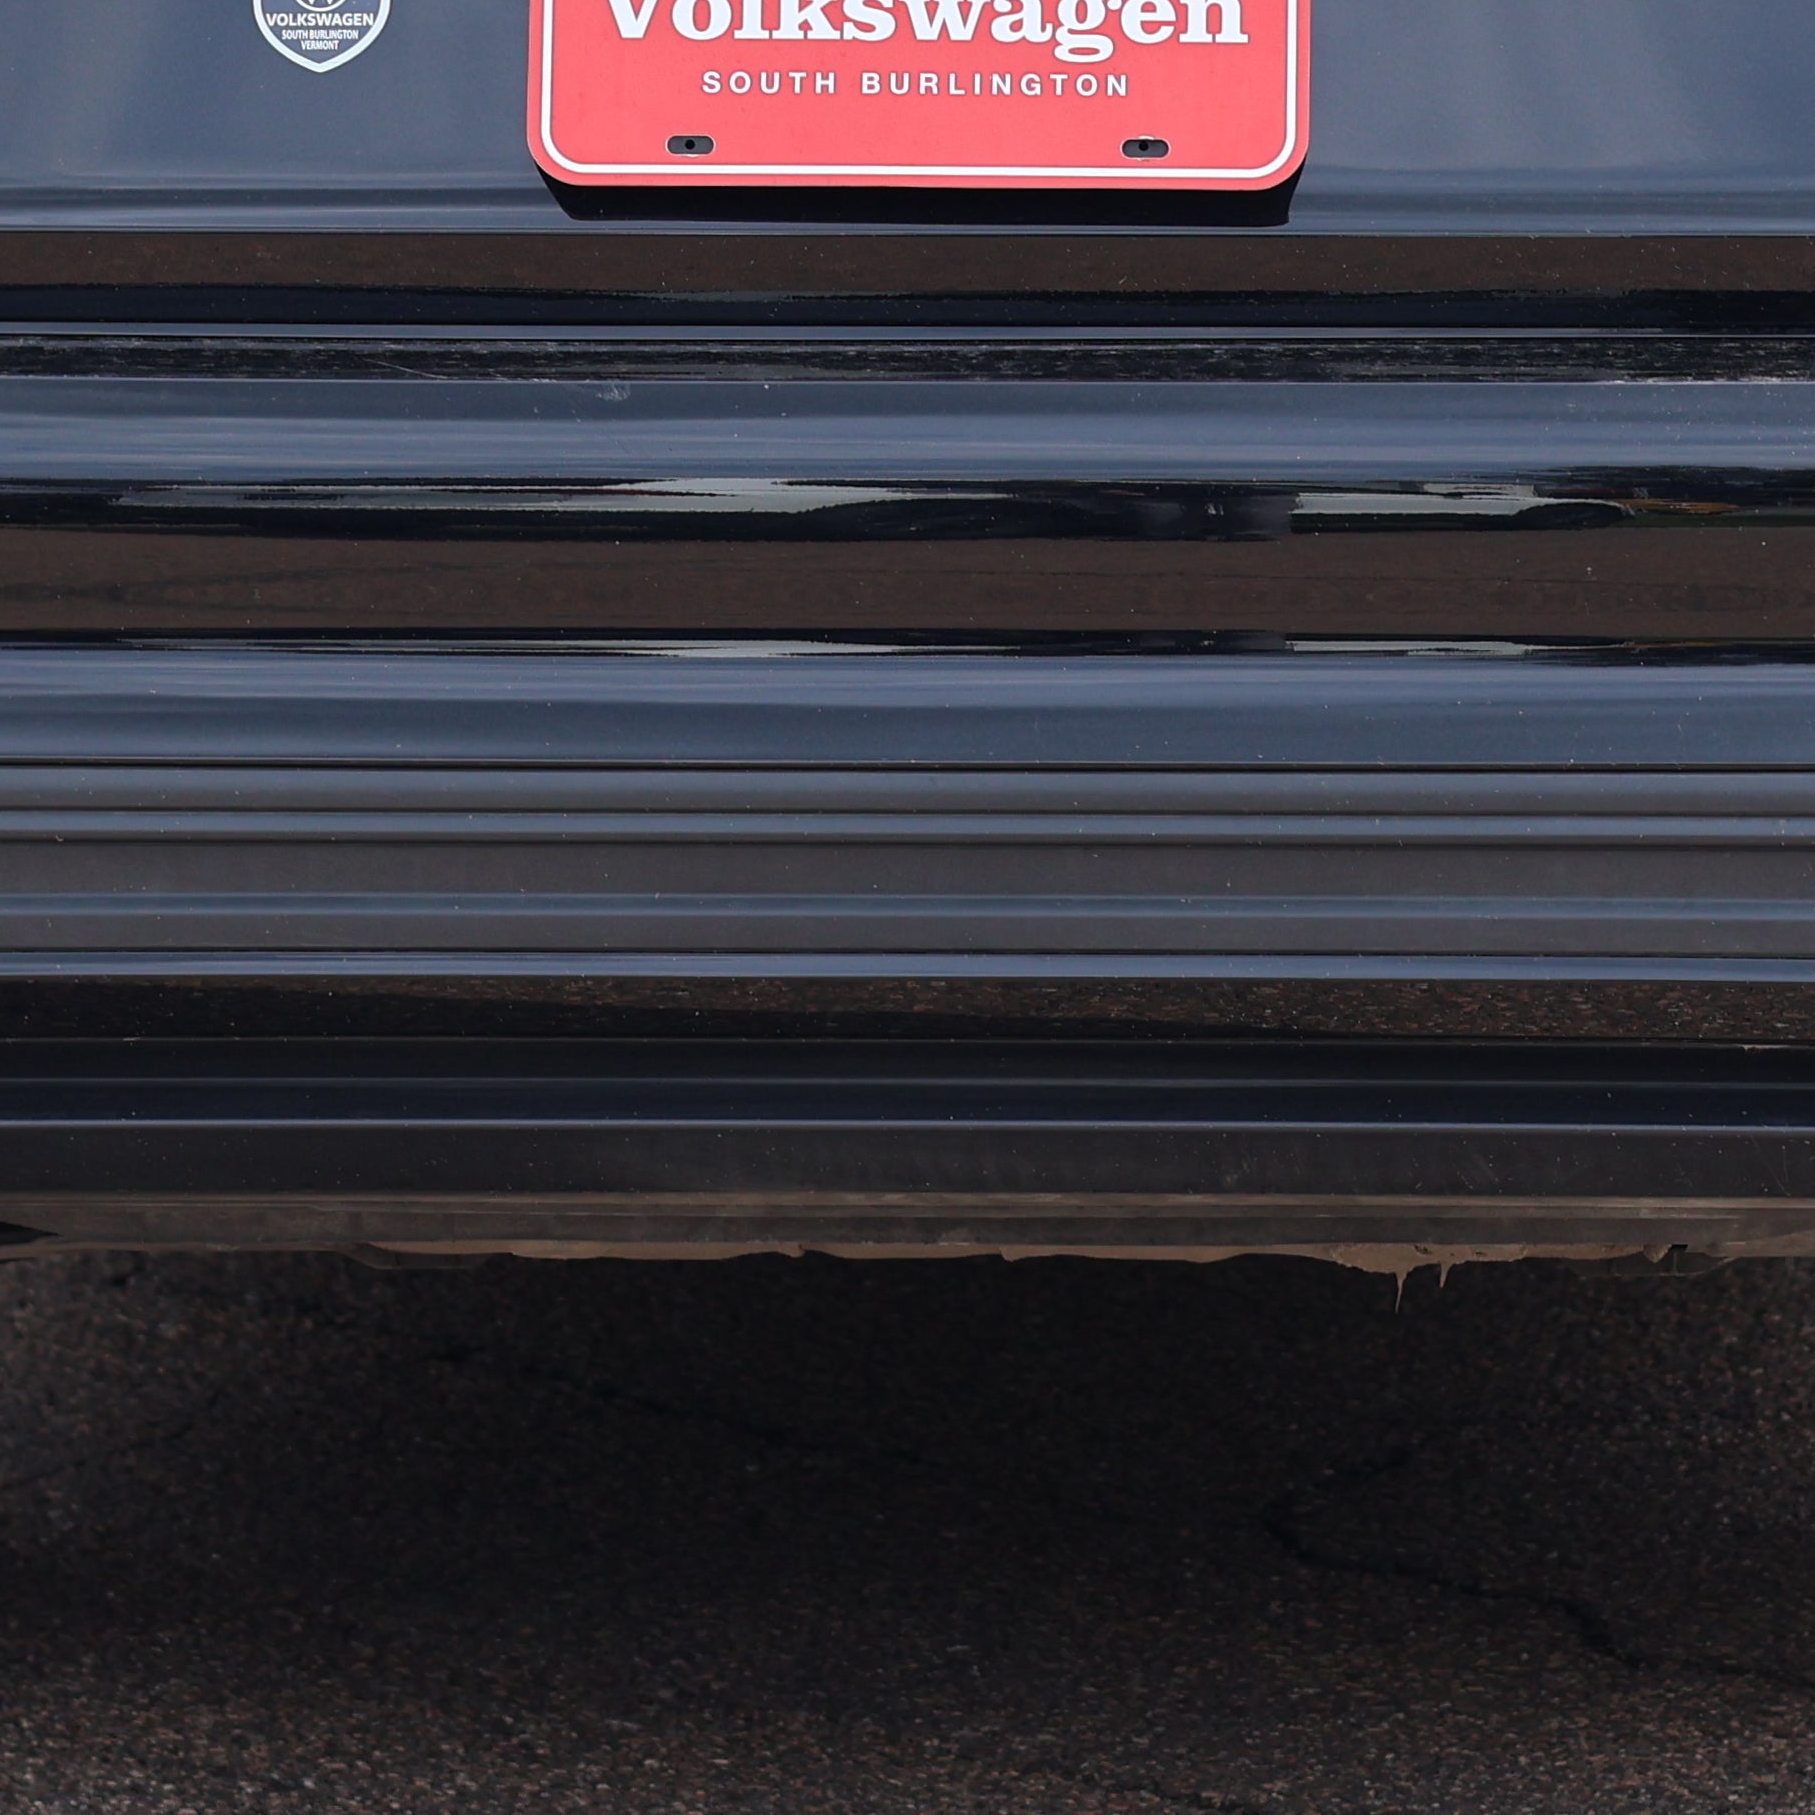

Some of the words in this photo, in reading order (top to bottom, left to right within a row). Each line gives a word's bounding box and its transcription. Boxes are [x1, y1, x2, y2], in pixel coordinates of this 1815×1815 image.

[265, 12, 375, 27] VOLKSWAGEN
[281, 29, 308, 40] SOUTH
[309, 29, 359, 40] BURLINGTON
[300, 41, 339, 50] VERMONT
[700, 69, 837, 96] SOUTH
[860, 71, 1129, 99] BURLINGTON
